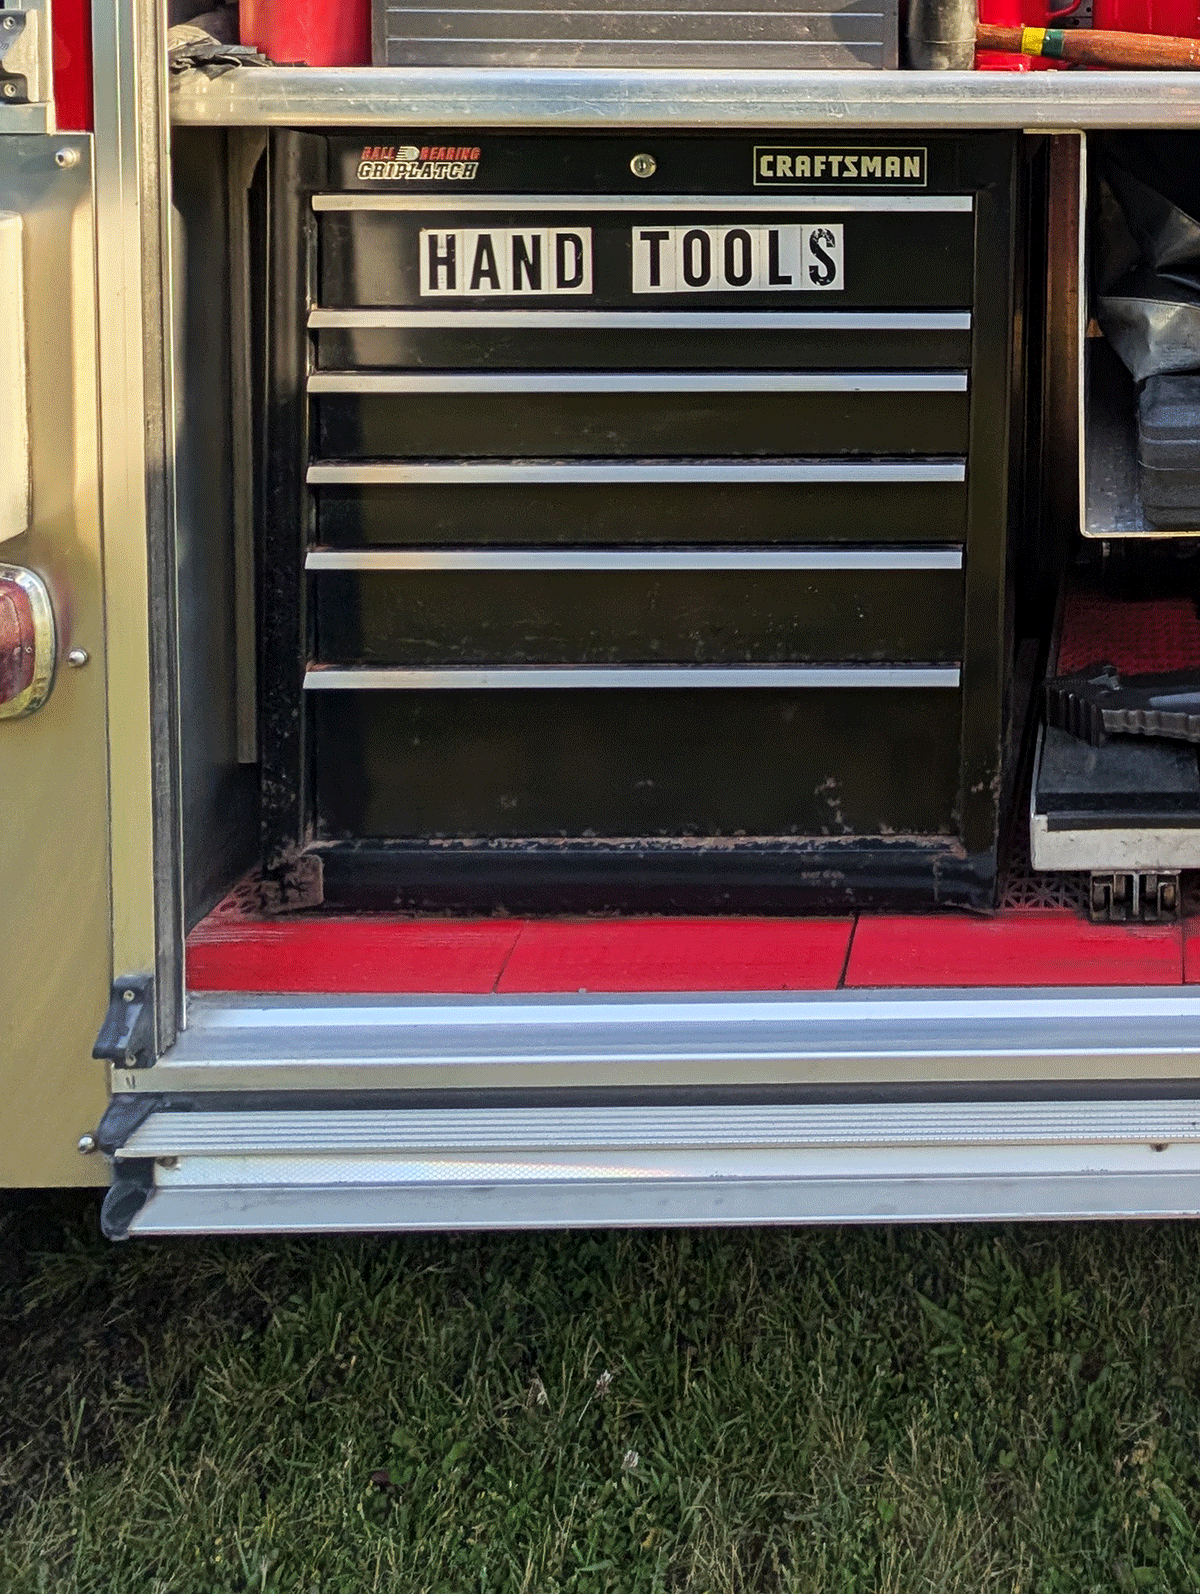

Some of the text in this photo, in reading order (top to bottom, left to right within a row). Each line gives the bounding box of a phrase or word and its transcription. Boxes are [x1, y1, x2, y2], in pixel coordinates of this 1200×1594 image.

[361, 146, 481, 161] BALL BEARING
[357, 161, 479, 180] GRIPLATCH
[760, 154, 922, 178] CRAFTSMAN
[428, 228, 838, 291] HAND TOOLS
